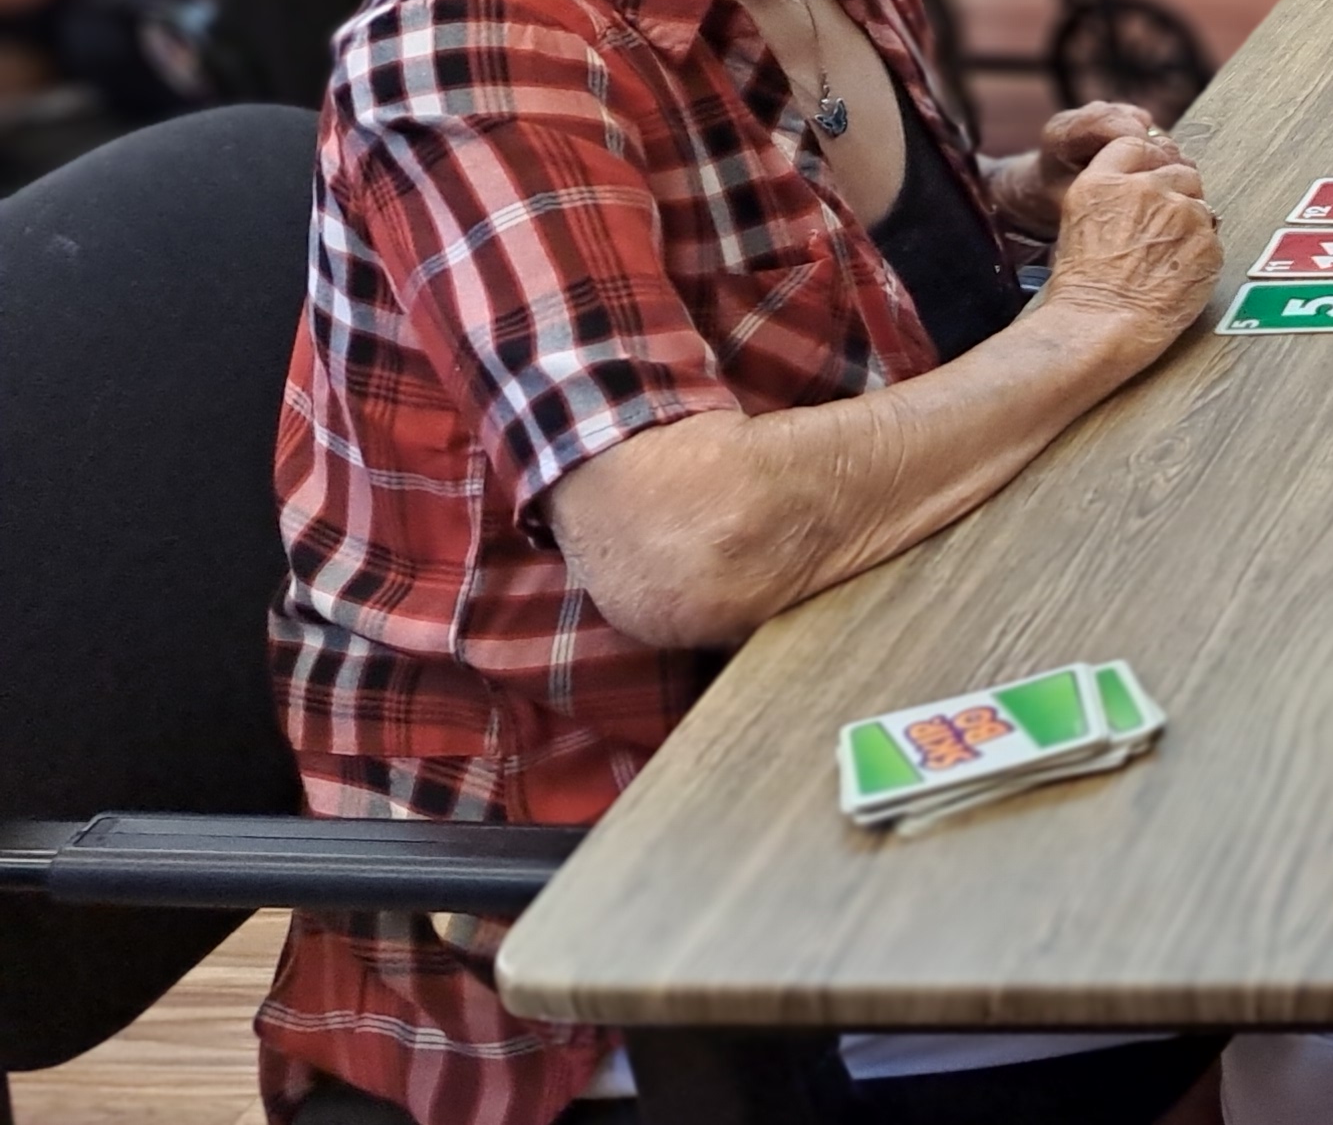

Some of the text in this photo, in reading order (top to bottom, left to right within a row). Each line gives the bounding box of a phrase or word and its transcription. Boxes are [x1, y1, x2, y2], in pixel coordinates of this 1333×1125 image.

[1302, 205, 1332, 219] 12
[1264, 259, 1295, 272] 11
[1231, 318, 1260, 329] 5
